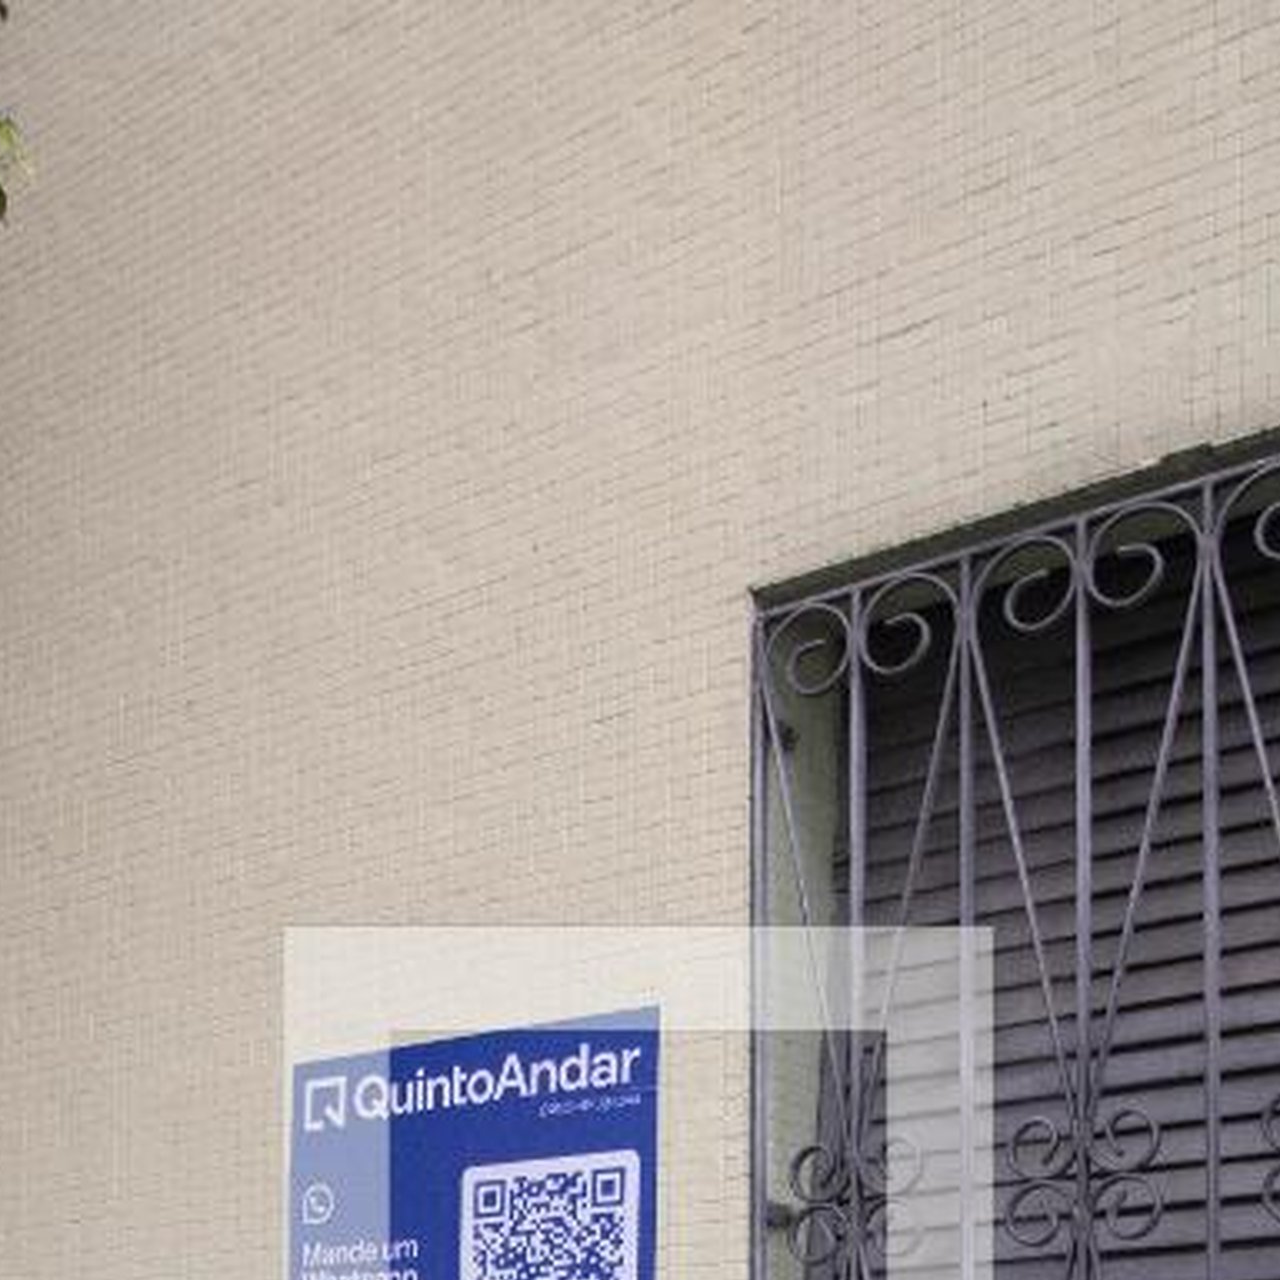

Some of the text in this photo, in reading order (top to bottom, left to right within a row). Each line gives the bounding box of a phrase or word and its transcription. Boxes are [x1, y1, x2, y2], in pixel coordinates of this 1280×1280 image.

[353, 1043, 642, 1121] QuintoAndar
[302, 1239, 419, 1266] Mande um
